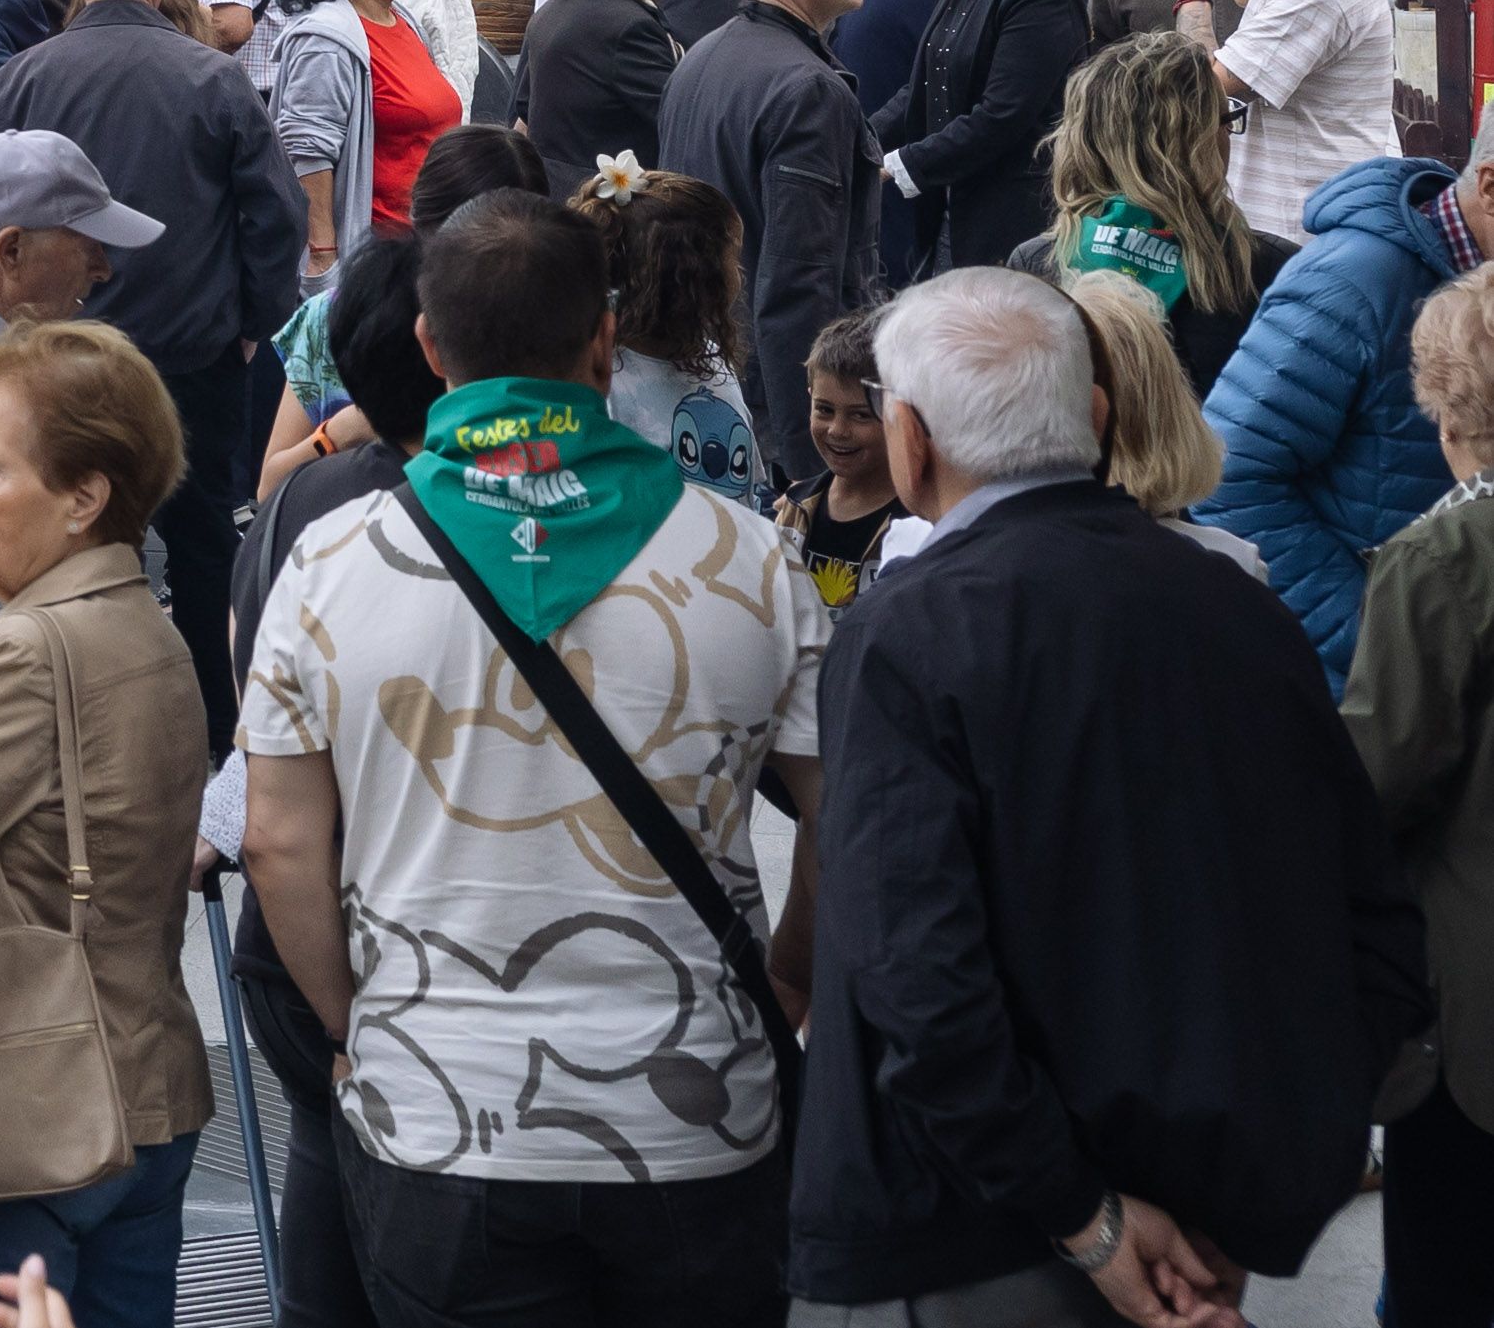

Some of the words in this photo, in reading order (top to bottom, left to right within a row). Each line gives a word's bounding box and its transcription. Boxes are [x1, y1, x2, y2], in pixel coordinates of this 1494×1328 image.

[1093, 224, 1124, 245] DE
[1122, 228, 1181, 265] MAIG
[456, 417, 530, 454] Festes
[539, 405, 580, 434] del
[508, 469, 589, 508] MAIG
